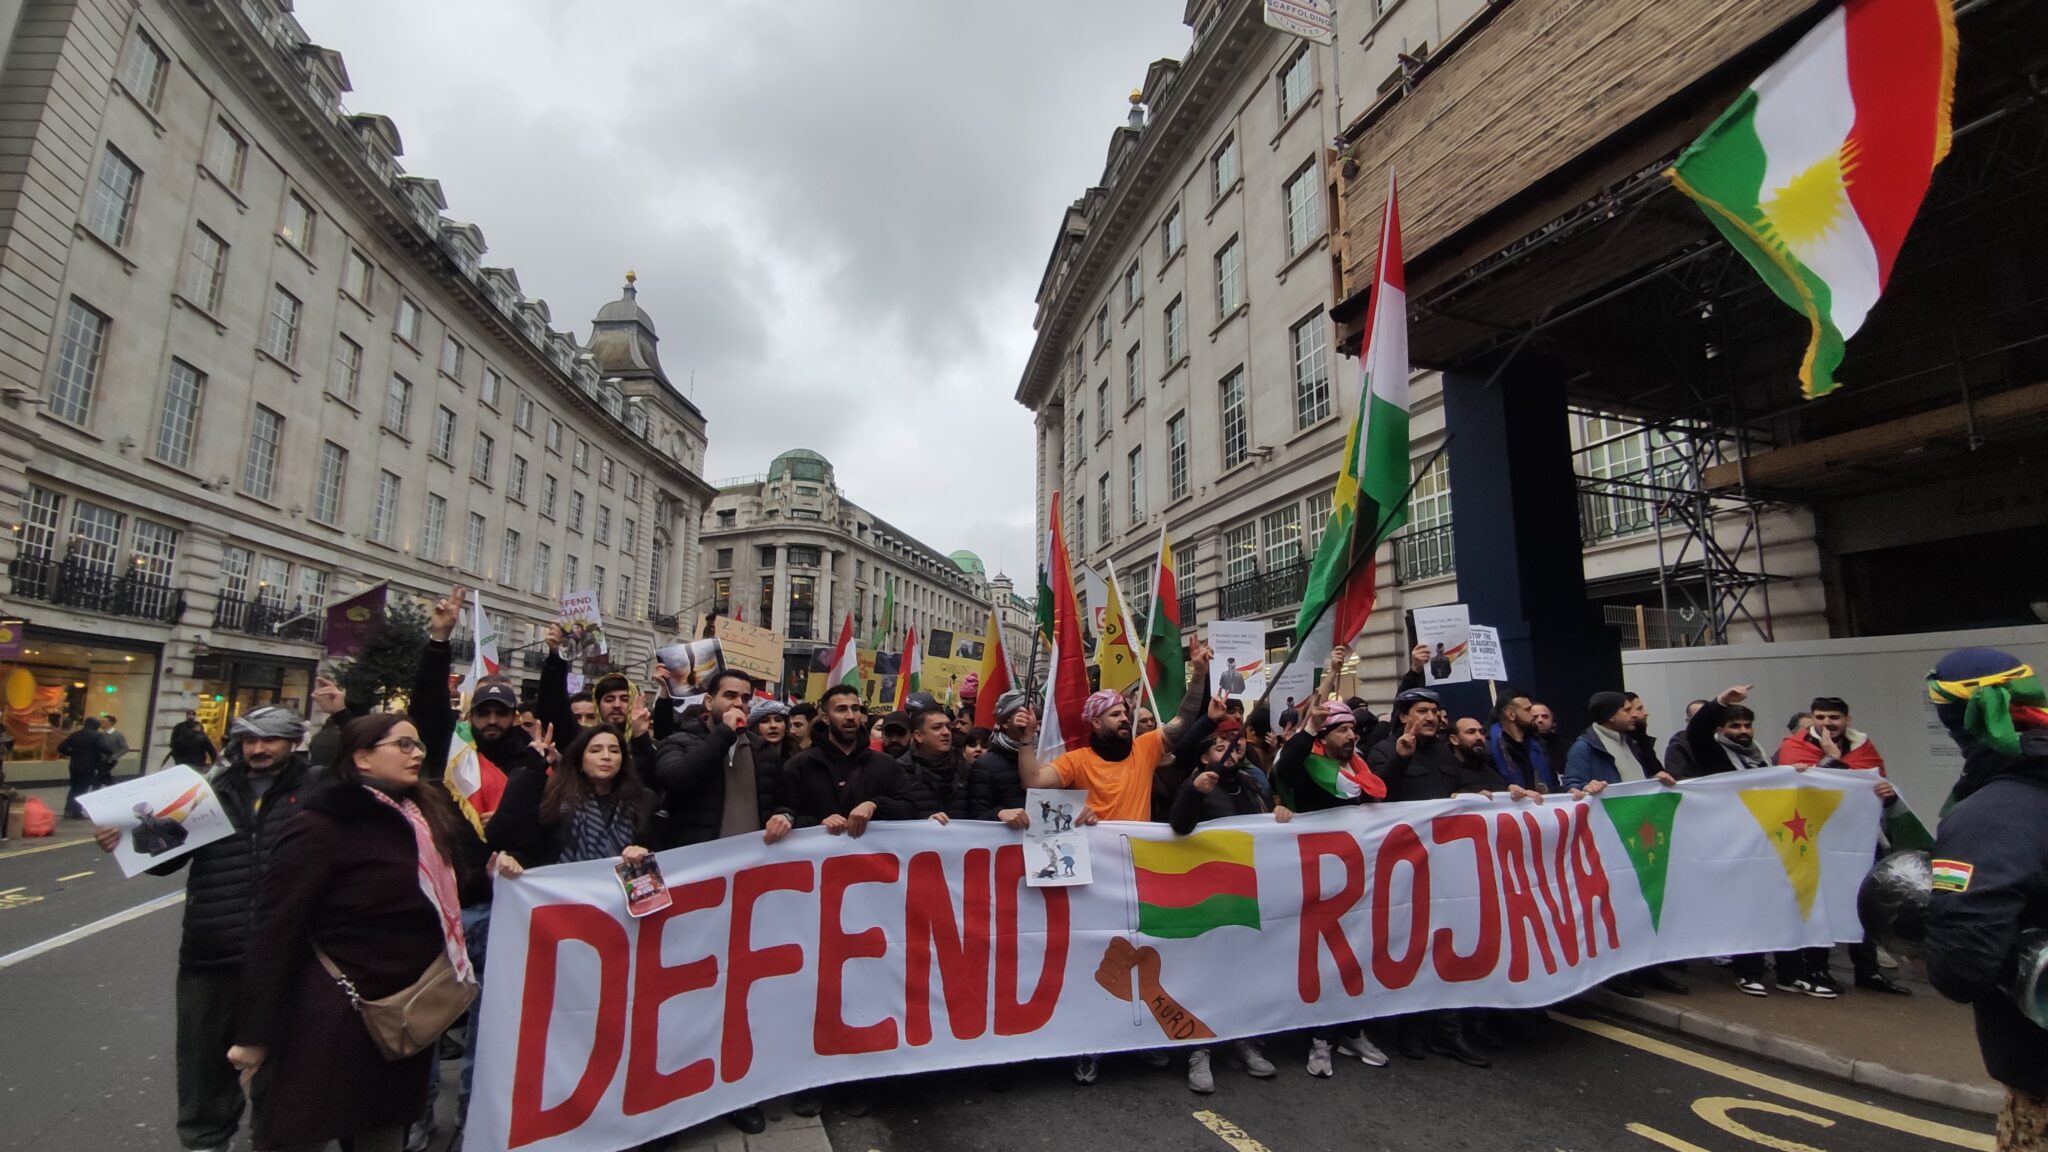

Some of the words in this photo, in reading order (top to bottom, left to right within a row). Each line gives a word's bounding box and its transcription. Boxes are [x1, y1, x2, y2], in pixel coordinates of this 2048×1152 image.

[560, 604, 593, 616] OJAVA
[508, 844, 1070, 1149] DEFEND
[1296, 803, 1621, 1003] ROJAVA
[1153, 994, 1195, 1040] KURD
